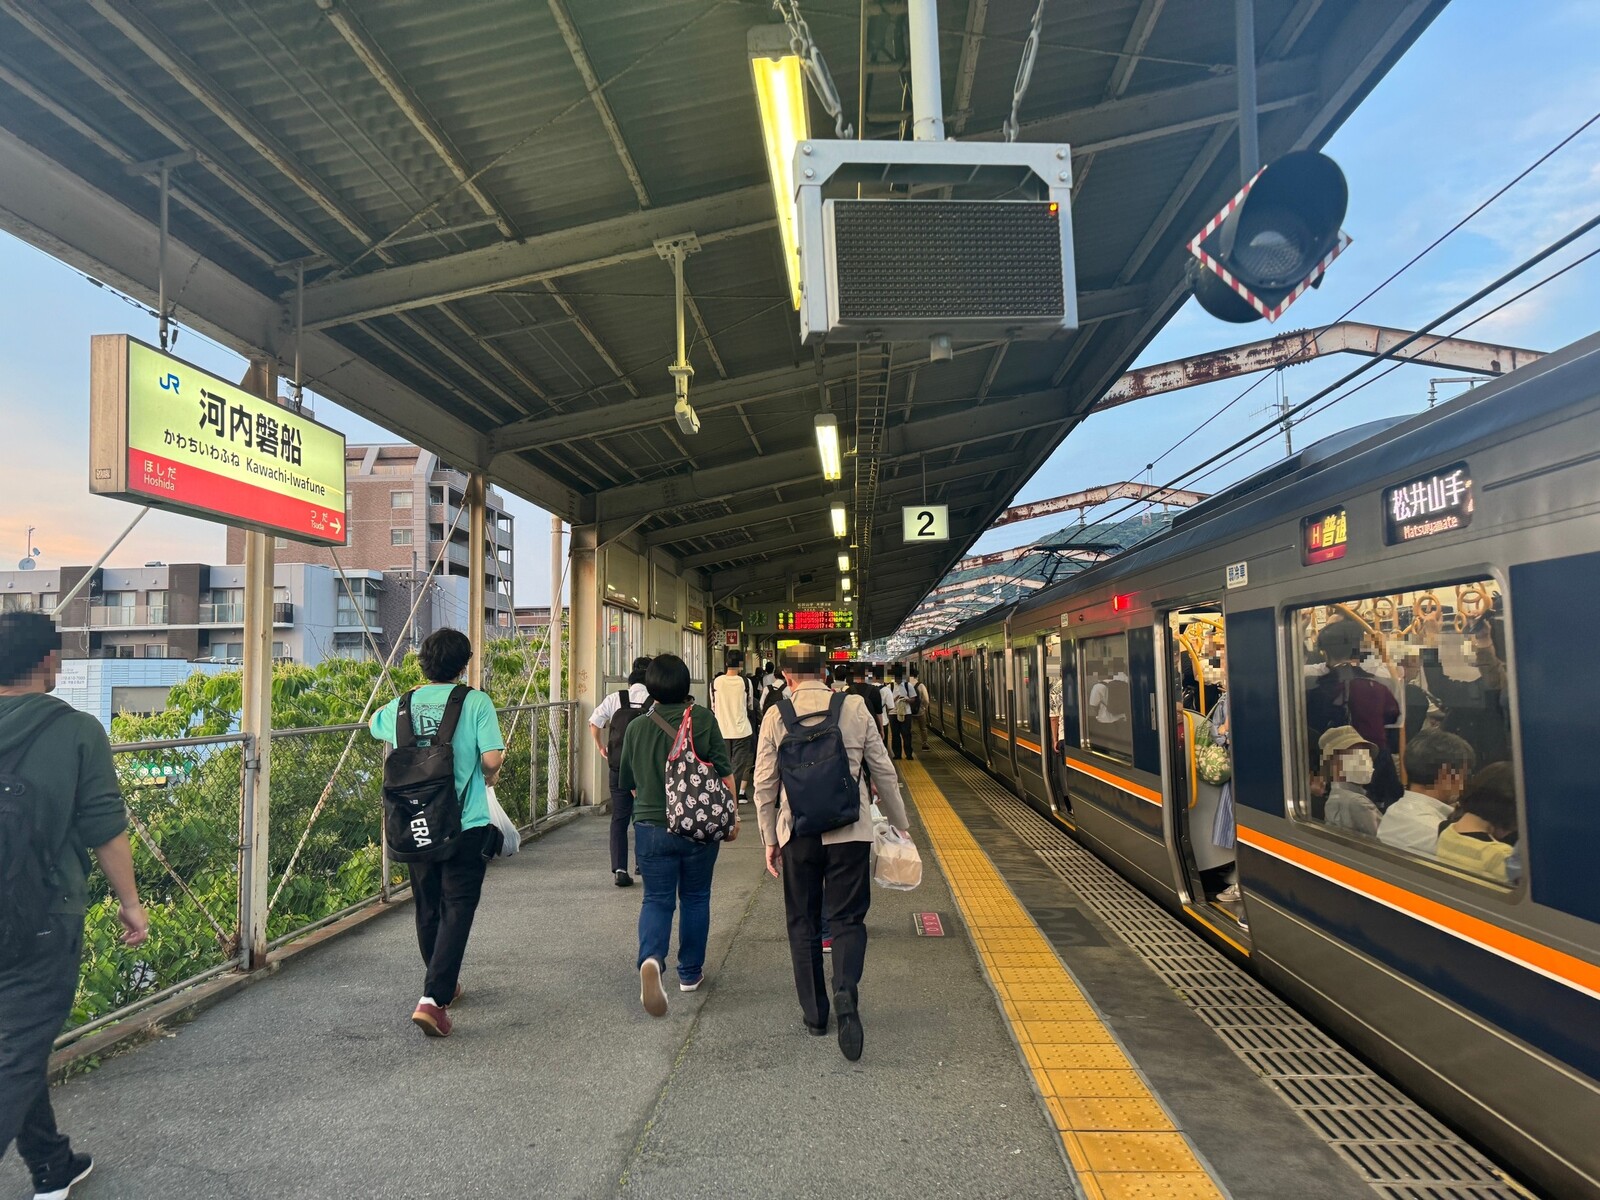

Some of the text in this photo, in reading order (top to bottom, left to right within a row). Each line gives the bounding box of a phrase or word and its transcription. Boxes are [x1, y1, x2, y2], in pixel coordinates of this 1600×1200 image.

[159, 373, 180, 395] JR
[199, 388, 302, 467] 河内磐船
[144, 459, 177, 480] ほしだ
[164, 428, 326, 497] かわちいわふね Kawachi-Iwafune
[143, 472, 176, 491] Hoshida
[1391, 469, 1466, 522] 松井山手
[916, 510, 936, 537] 2
[410, 817, 432, 848] ERA
